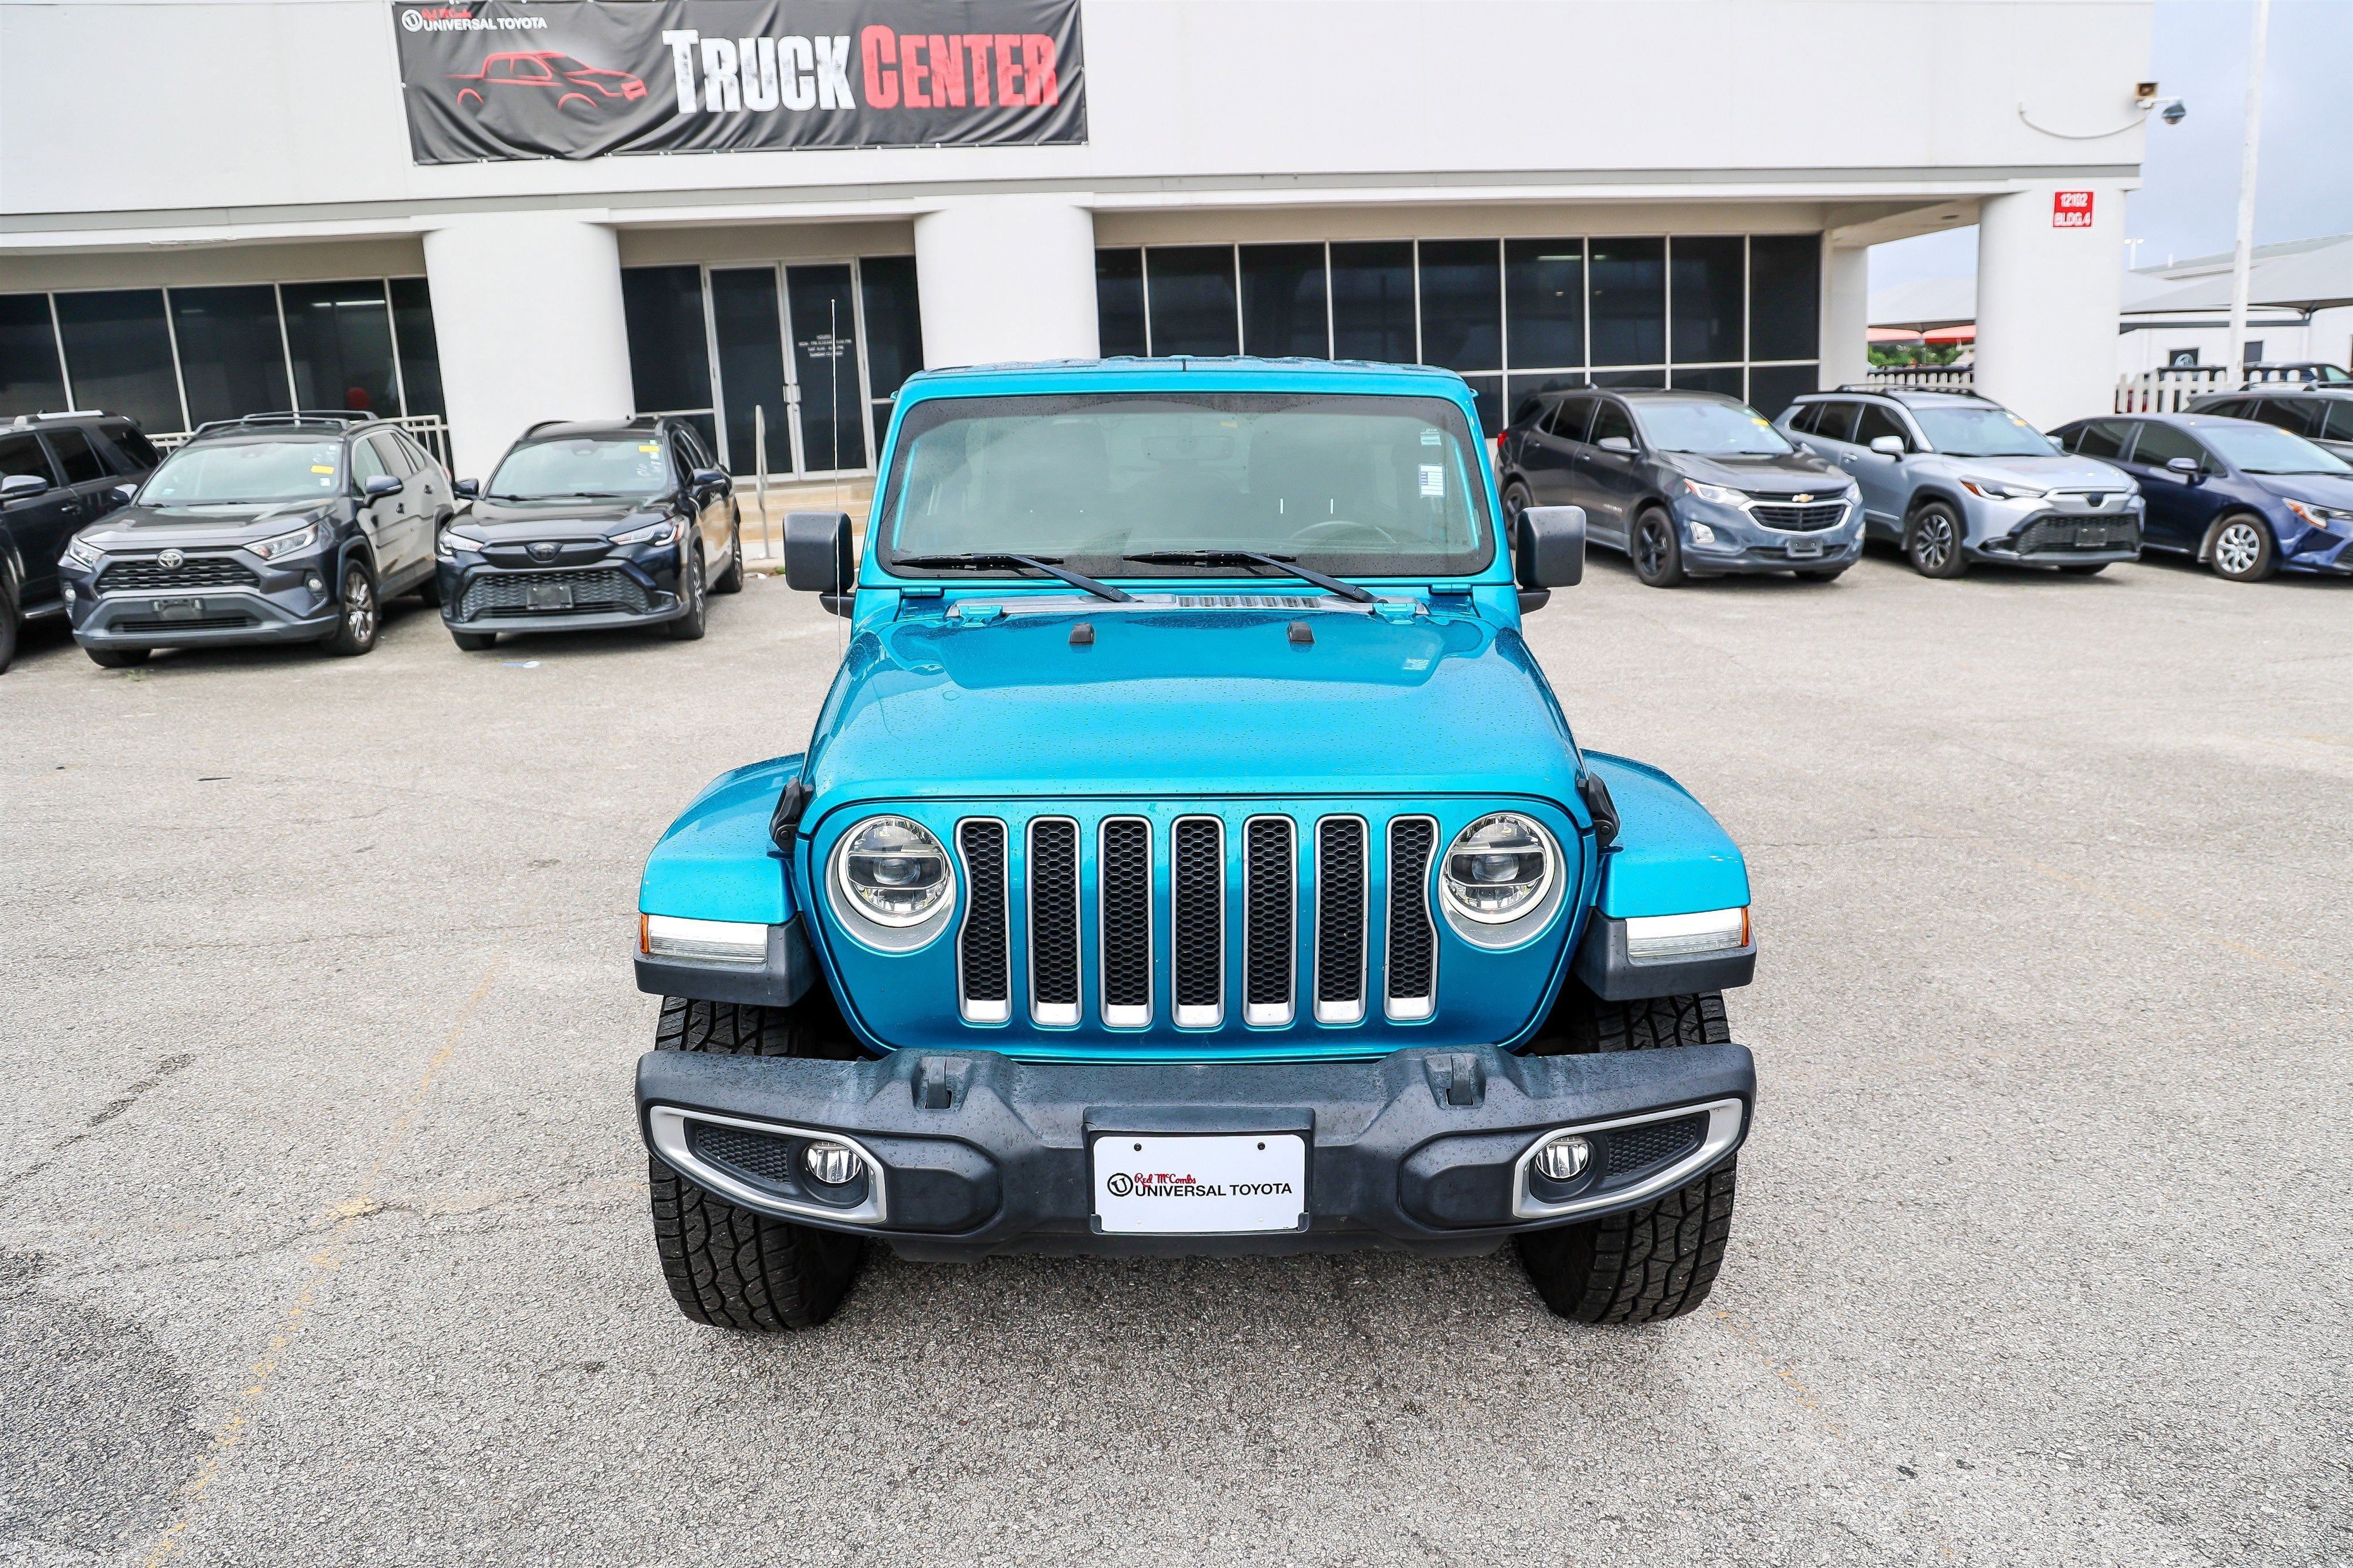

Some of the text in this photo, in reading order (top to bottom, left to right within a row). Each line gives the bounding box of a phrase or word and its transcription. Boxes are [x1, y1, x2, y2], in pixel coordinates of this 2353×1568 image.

[423, 17, 548, 32] UNIVERSAL TOYOTA
[661, 25, 1059, 113] TRUCK CENTER
[1134, 1173, 1196, 1187] Red McCombs
[1136, 1183, 1293, 1197] UNIVERSAL TOYOTA
